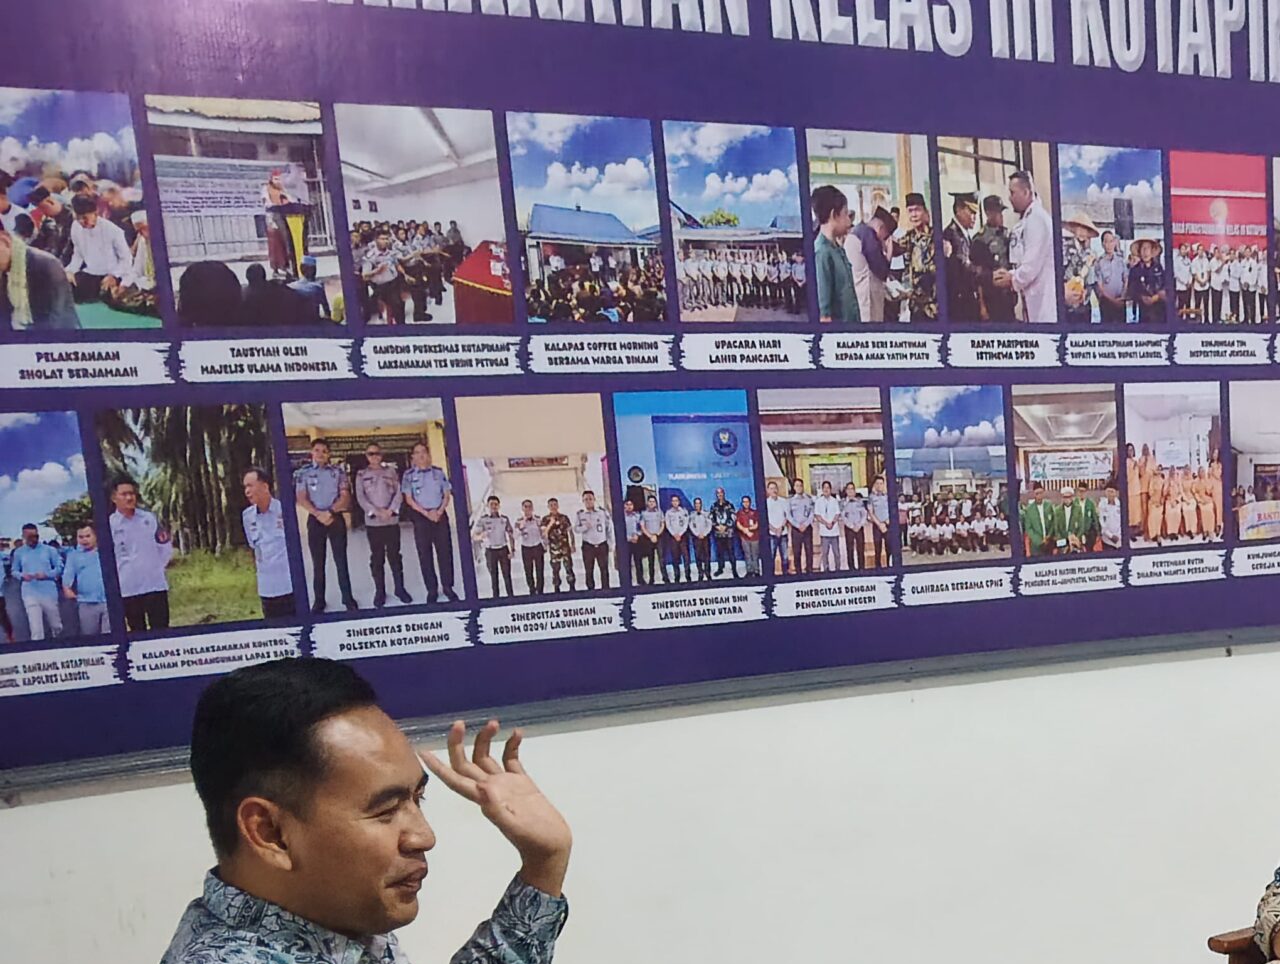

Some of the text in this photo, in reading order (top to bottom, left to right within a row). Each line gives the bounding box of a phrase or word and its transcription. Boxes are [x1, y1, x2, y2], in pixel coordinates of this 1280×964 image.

[373, 343, 511, 354] GANDENG PUSKESMAS KOTAPINANG
[545, 342, 658, 351] KALAPAS COFFEE MORNING
[715, 340, 781, 349] UPACARA HARI
[837, 340, 926, 349] KALAPAS BERI SANTUNAN
[971, 340, 1039, 349] RAPAT PARIPURNA
[1070, 340, 1097, 348] KALAPAS
[36, 351, 120, 362] PELAKSANAAN
[230, 347, 307, 357] TAUSYIAH OLEH
[835, 352, 929, 361] KEPADA ANAK YATIM PIATU
[977, 351, 1035, 361] ISTIMEWA DPRD
[1070, 351, 1091, 359] BUPATI
[1117, 351, 1137, 359] BUPATI
[378, 358, 508, 369] LAKSANAKAN TES URINE PETUGAS
[548, 356, 658, 366] BERSAMA WARGA BINAAN
[709, 354, 789, 364] LAHIR PANCASILA
[19, 367, 138, 379] SHOLAT BERJAMAAH
[201, 362, 337, 374] MAJELIS ULAMA INDONESIA
[1152, 557, 1204, 569] PERTEMUAN RUTIN
[1252, 562, 1275, 571] GEREJA
[1035, 569, 1057, 578] KALAPAS
[1137, 566, 1219, 580] DHARMA WANITA PERSATUAN
[796, 585, 875, 597] SINERGITAS DENGAN
[911, 579, 1003, 594] OLAHRAGA BERSAMA CPNS
[652, 595, 748, 609] SINERGITAS DENGAN BNN
[796, 596, 875, 609] PENGADILAN NEGERI
[511, 607, 595, 621] SINERGITAS DENGAN
[659, 606, 742, 620] LABUHANBATU UTARA
[346, 622, 442, 637] SINERGITAS DENGAN
[493, 626, 522, 635] KODIM
[551, 619, 590, 629] LABUHAN
[592, 617, 612, 626] BATU
[339, 634, 449, 651] POLSEKTA KOTAPINANG
[142, 639, 288, 659] KALAPAS MELAKSANAKAN KONTROL
[61, 657, 105, 668] KOTAPINANG
[136, 650, 295, 673] KE LAHAN PEMBANGUNAN LAPAS BARU
[23, 674, 59, 685] KAPOLRES
[60, 672, 90, 682] LABUSEL
